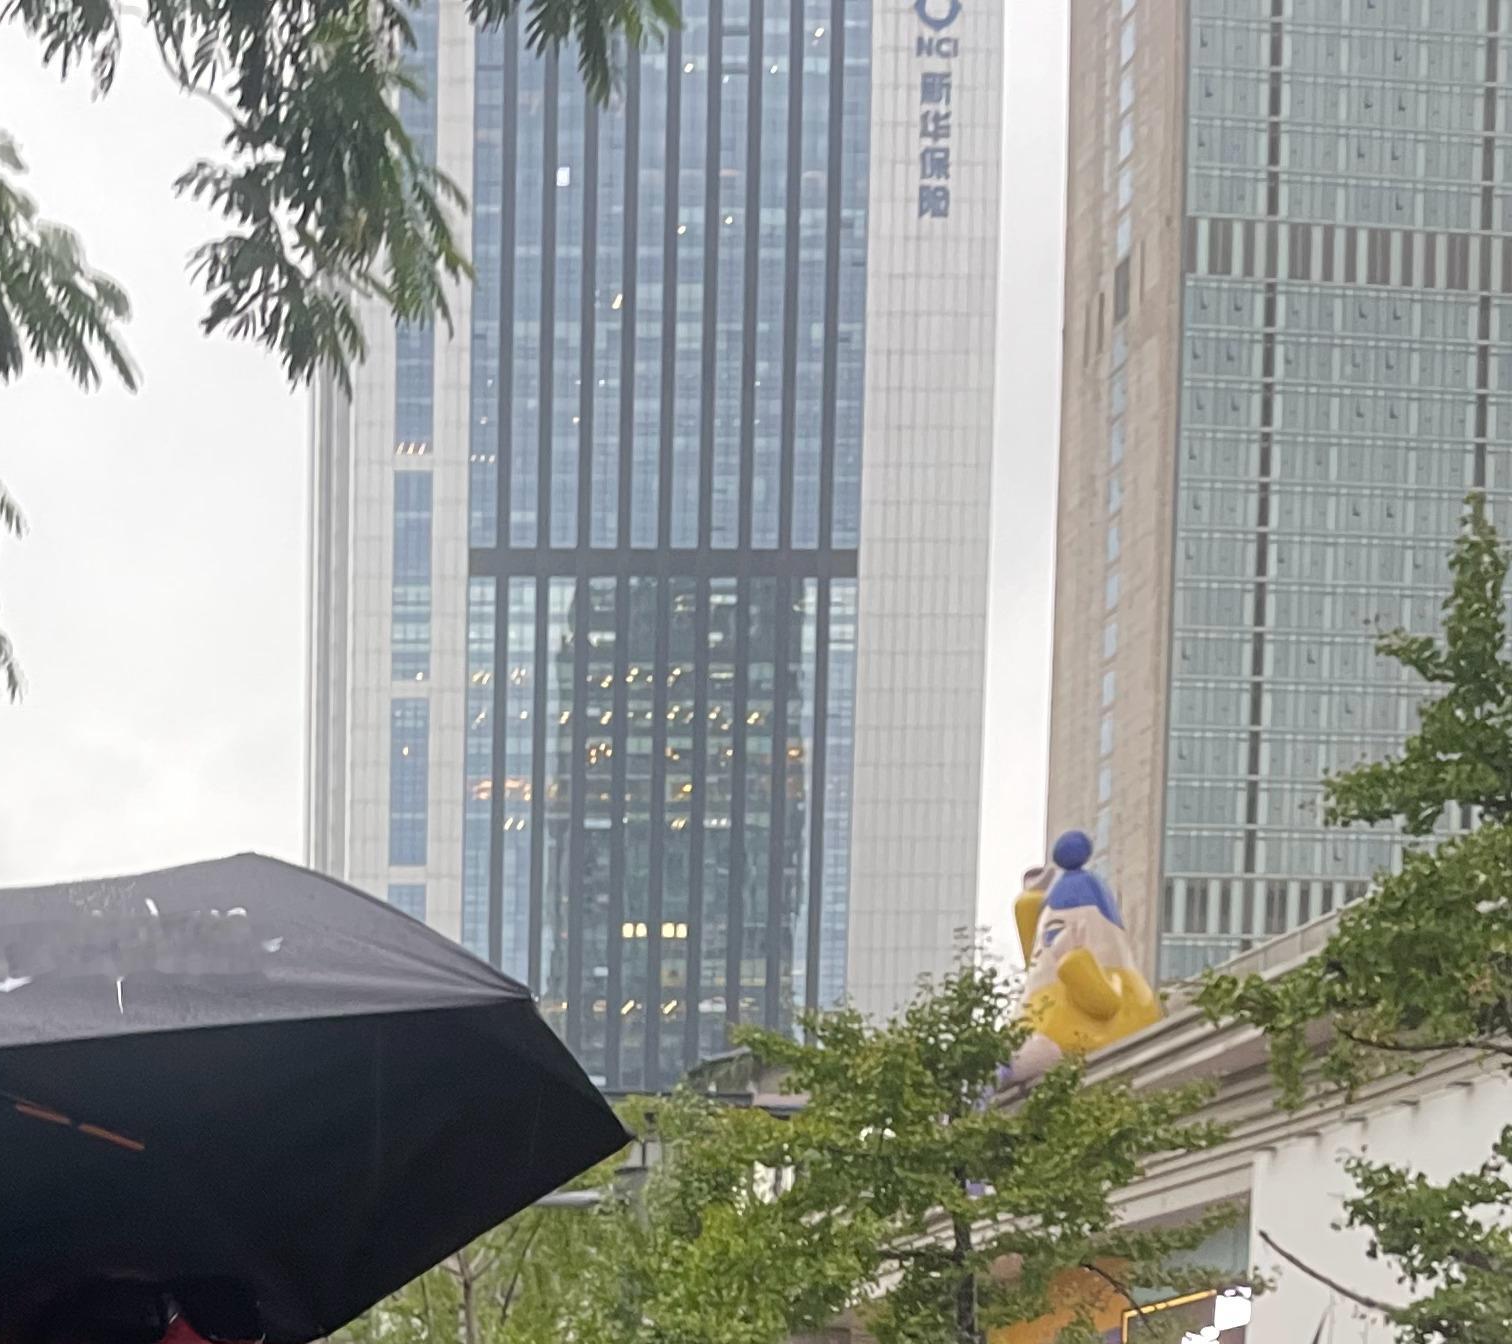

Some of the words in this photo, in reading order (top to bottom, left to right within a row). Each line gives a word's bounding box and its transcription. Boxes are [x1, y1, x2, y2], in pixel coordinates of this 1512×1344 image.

[916, 36, 959, 58] NCI
[918, 72, 952, 219] 新华保险
